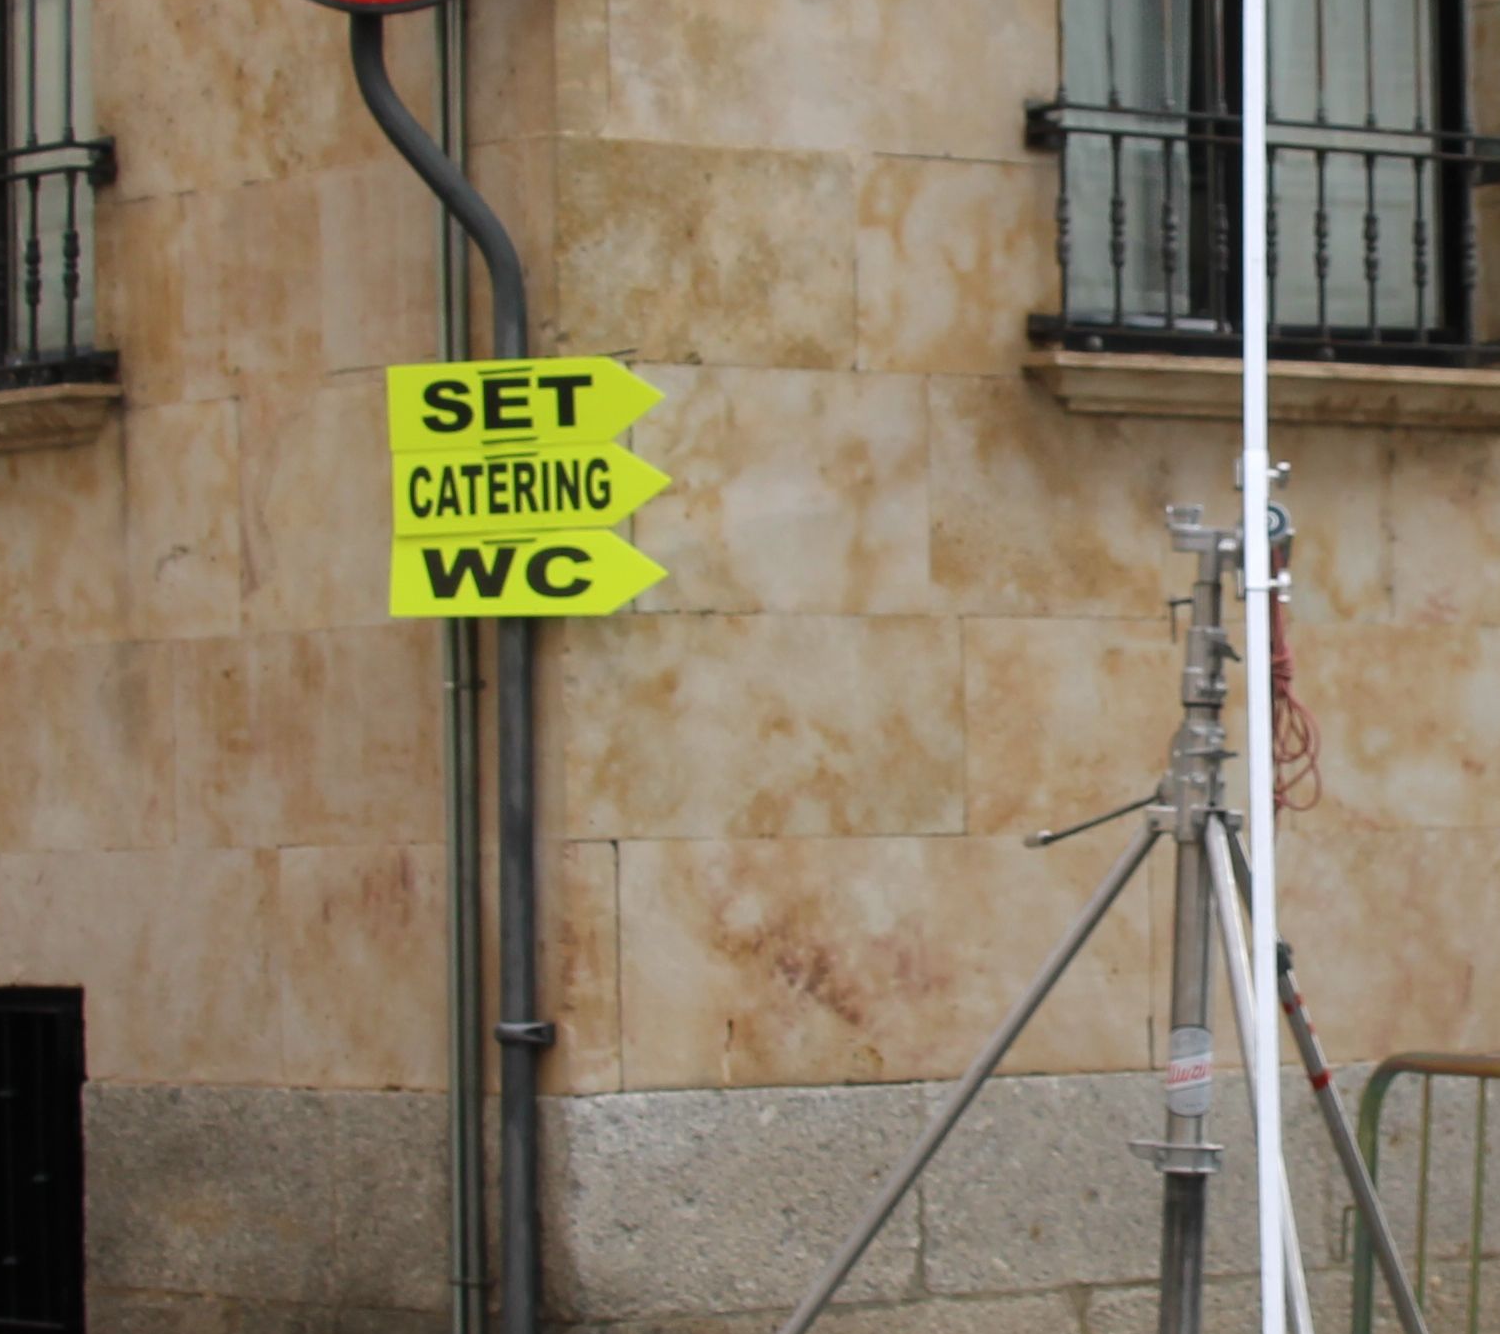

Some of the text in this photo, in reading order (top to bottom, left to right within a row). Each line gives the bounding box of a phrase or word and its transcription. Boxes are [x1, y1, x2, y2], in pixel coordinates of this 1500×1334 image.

[422, 375, 592, 433] SET
[409, 457, 611, 518] CATERING
[422, 546, 593, 598] WC
